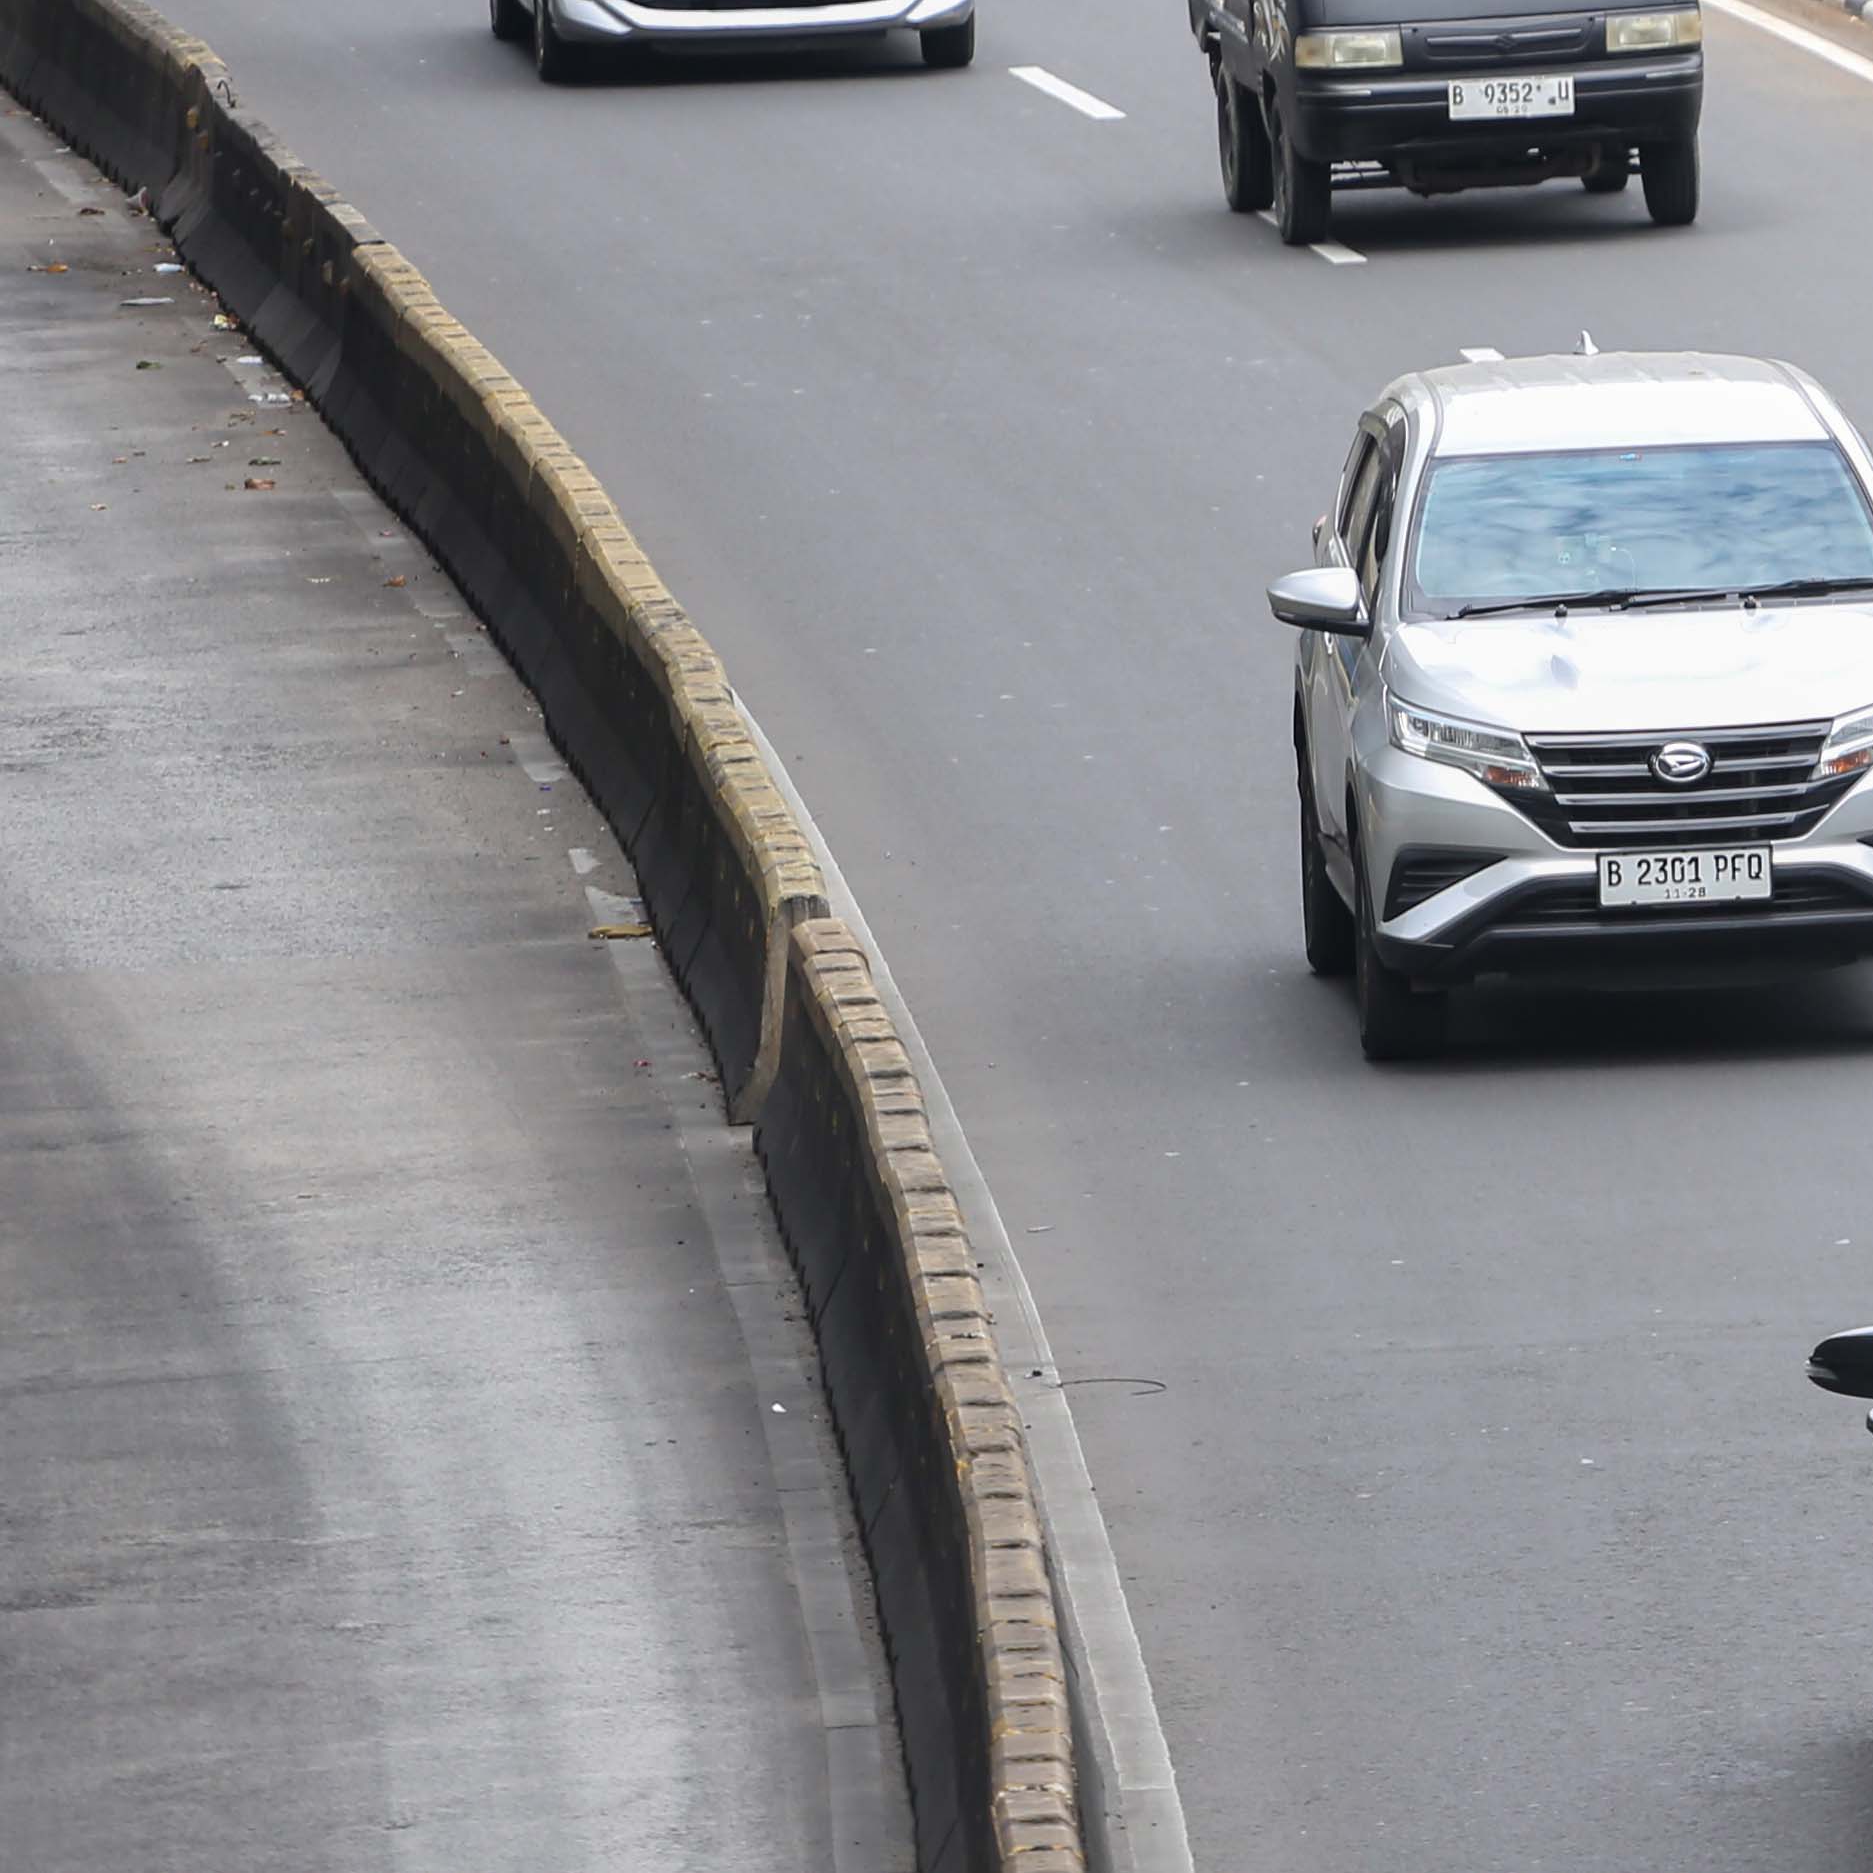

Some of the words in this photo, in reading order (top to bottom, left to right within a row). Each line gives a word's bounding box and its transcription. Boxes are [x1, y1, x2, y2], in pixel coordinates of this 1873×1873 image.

[1453, 85, 1464, 105] B
[1484, 82, 1534, 104] 9352
[1607, 860, 1622, 887] B
[1637, 856, 1703, 887] 2301
[1713, 852, 1762, 883] PFQ
